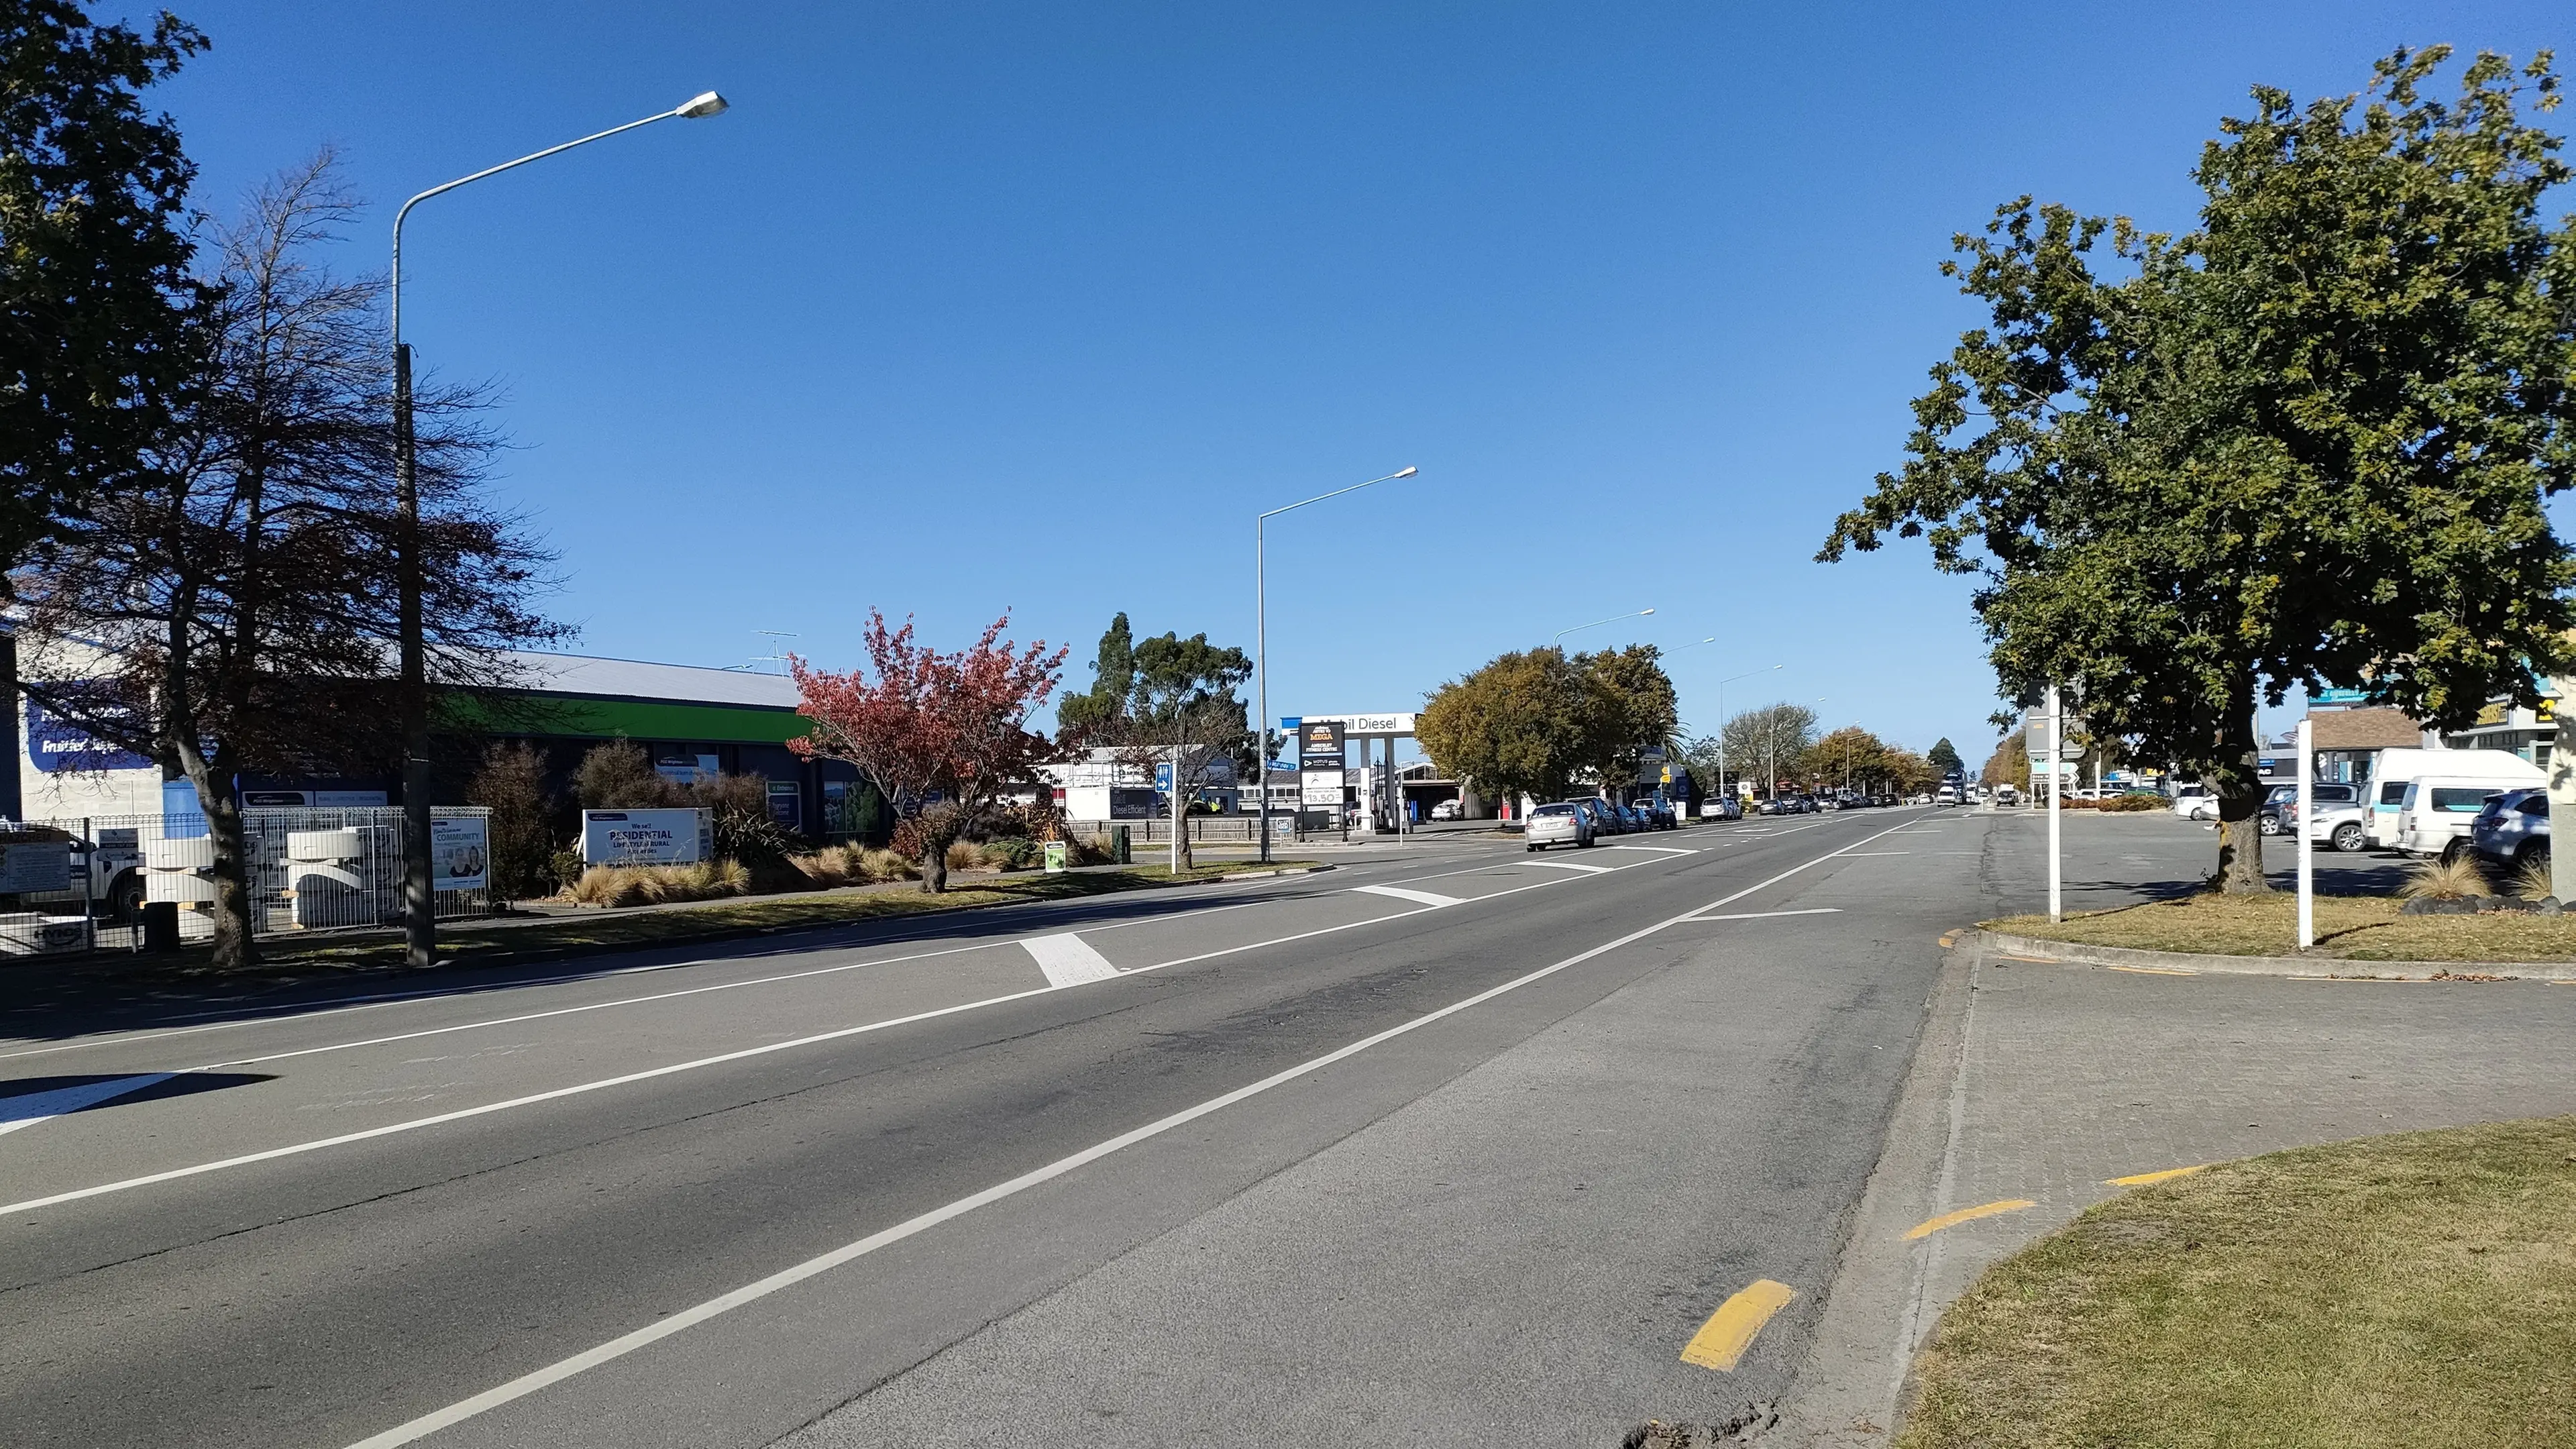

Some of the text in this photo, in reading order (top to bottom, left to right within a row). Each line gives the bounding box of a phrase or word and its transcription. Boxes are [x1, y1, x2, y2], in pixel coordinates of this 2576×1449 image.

[1359, 718, 1396, 730] Diesel
[1304, 794, 1334, 802] $13.50
[1113, 805, 1127, 814] Diesel
[1128, 804, 1146, 814] Efficient
[437, 833, 480, 841] COMMUNITY
